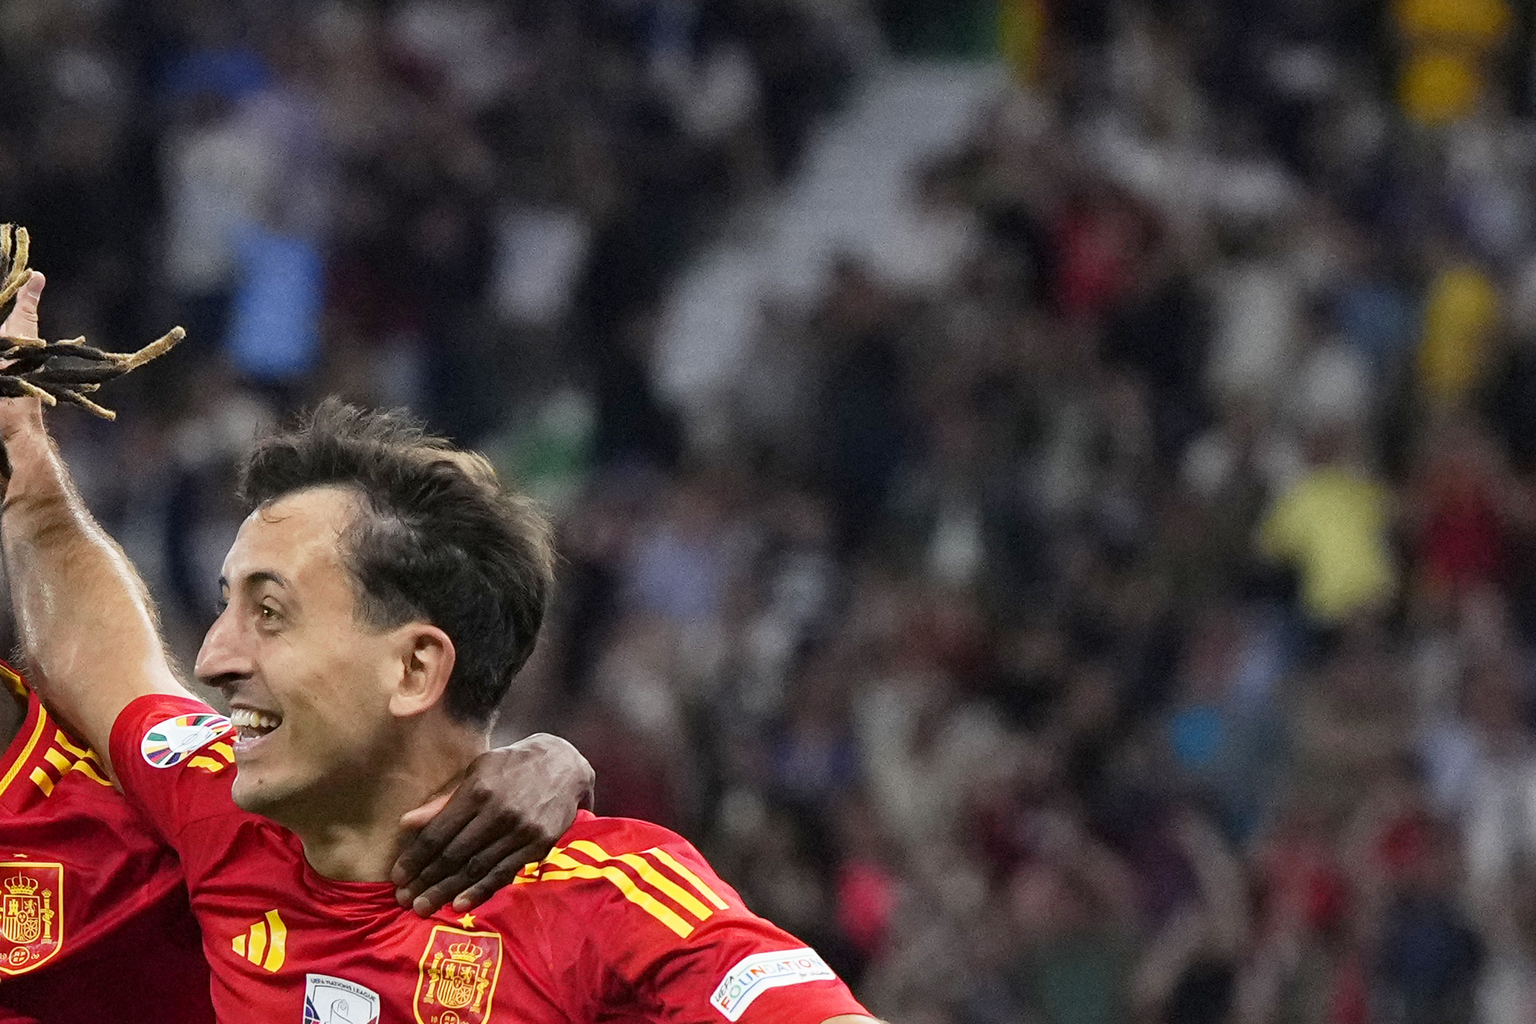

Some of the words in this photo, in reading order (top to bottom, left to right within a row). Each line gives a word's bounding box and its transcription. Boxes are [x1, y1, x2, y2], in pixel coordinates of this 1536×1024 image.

[325, 980, 353, 991] NATIONS
[353, 986, 377, 1002] LEAGUE
[714, 975, 736, 1003] UEFA
[720, 958, 824, 1010] FOUNDATION
